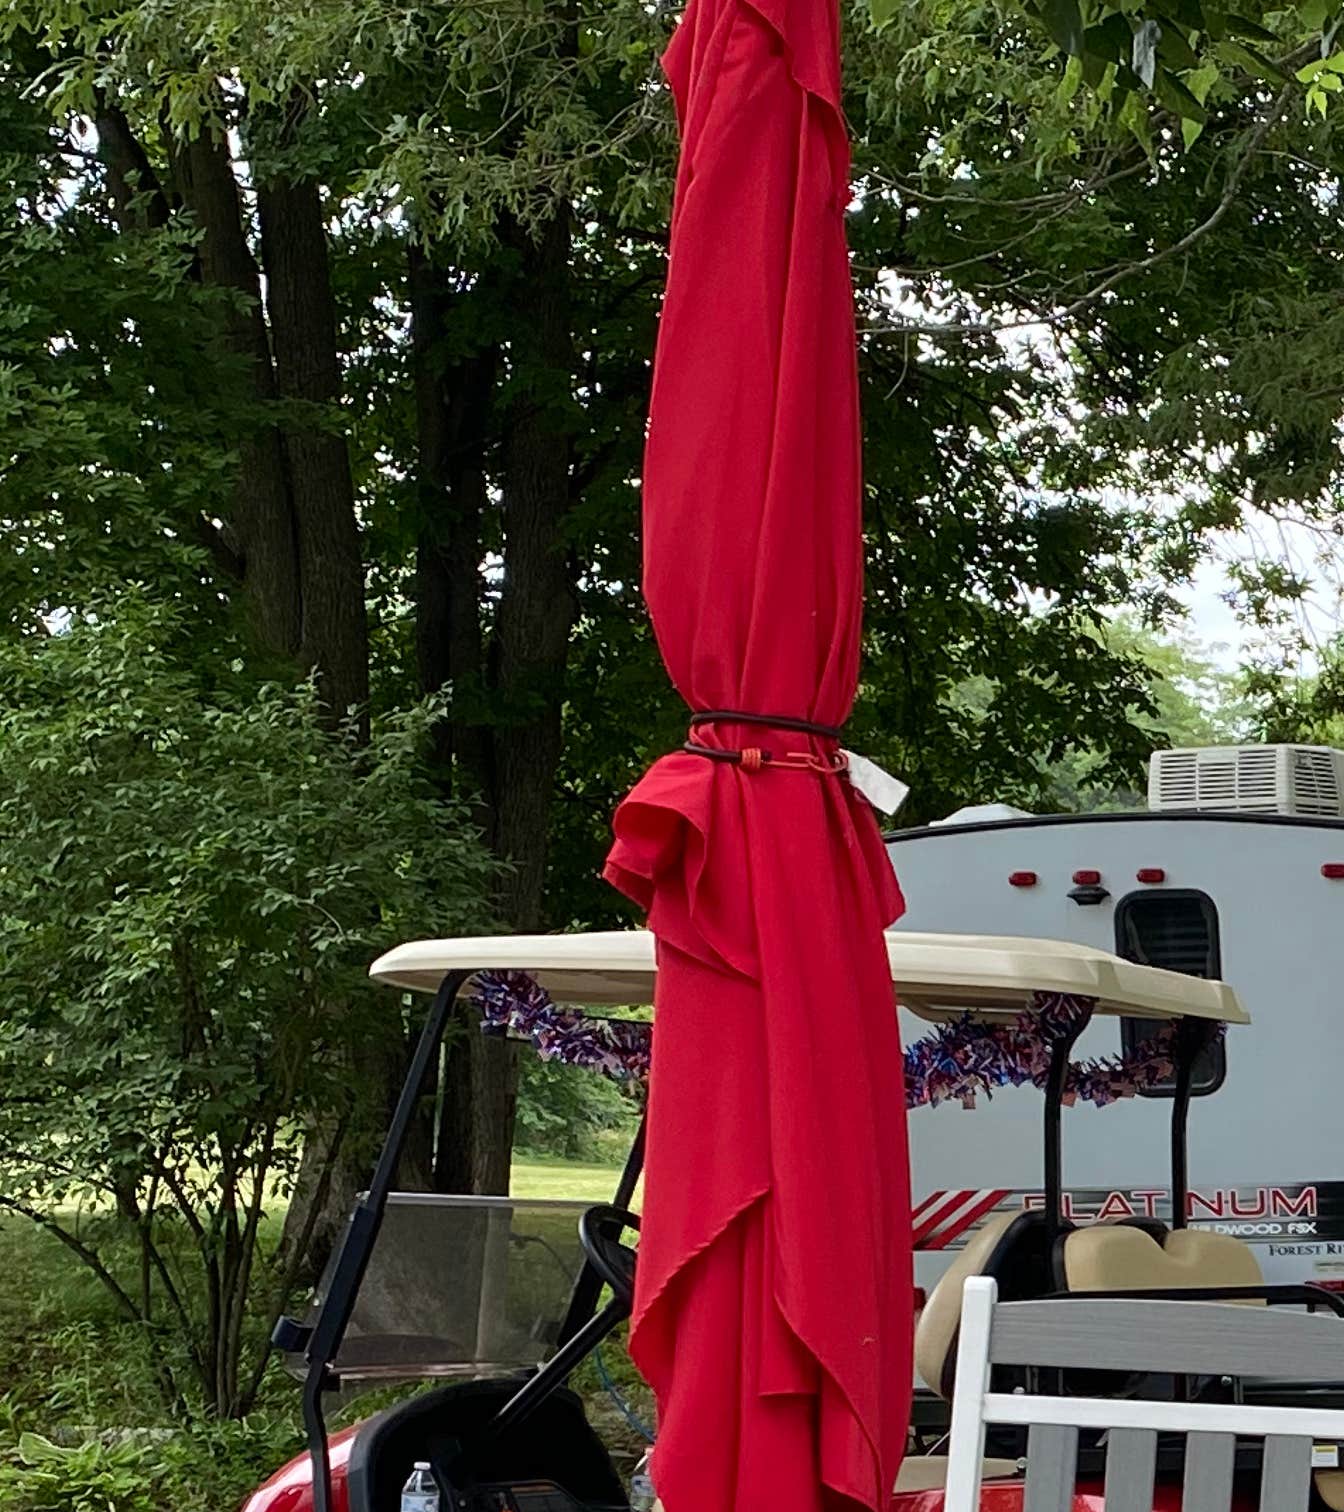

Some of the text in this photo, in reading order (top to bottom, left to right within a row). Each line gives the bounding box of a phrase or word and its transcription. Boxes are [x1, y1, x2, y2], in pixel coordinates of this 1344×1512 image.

[1023, 1186, 1318, 1220] LATNUM
[1188, 1222, 1282, 1235] DWOOD
[1268, 1243, 1322, 1256] FOREST
